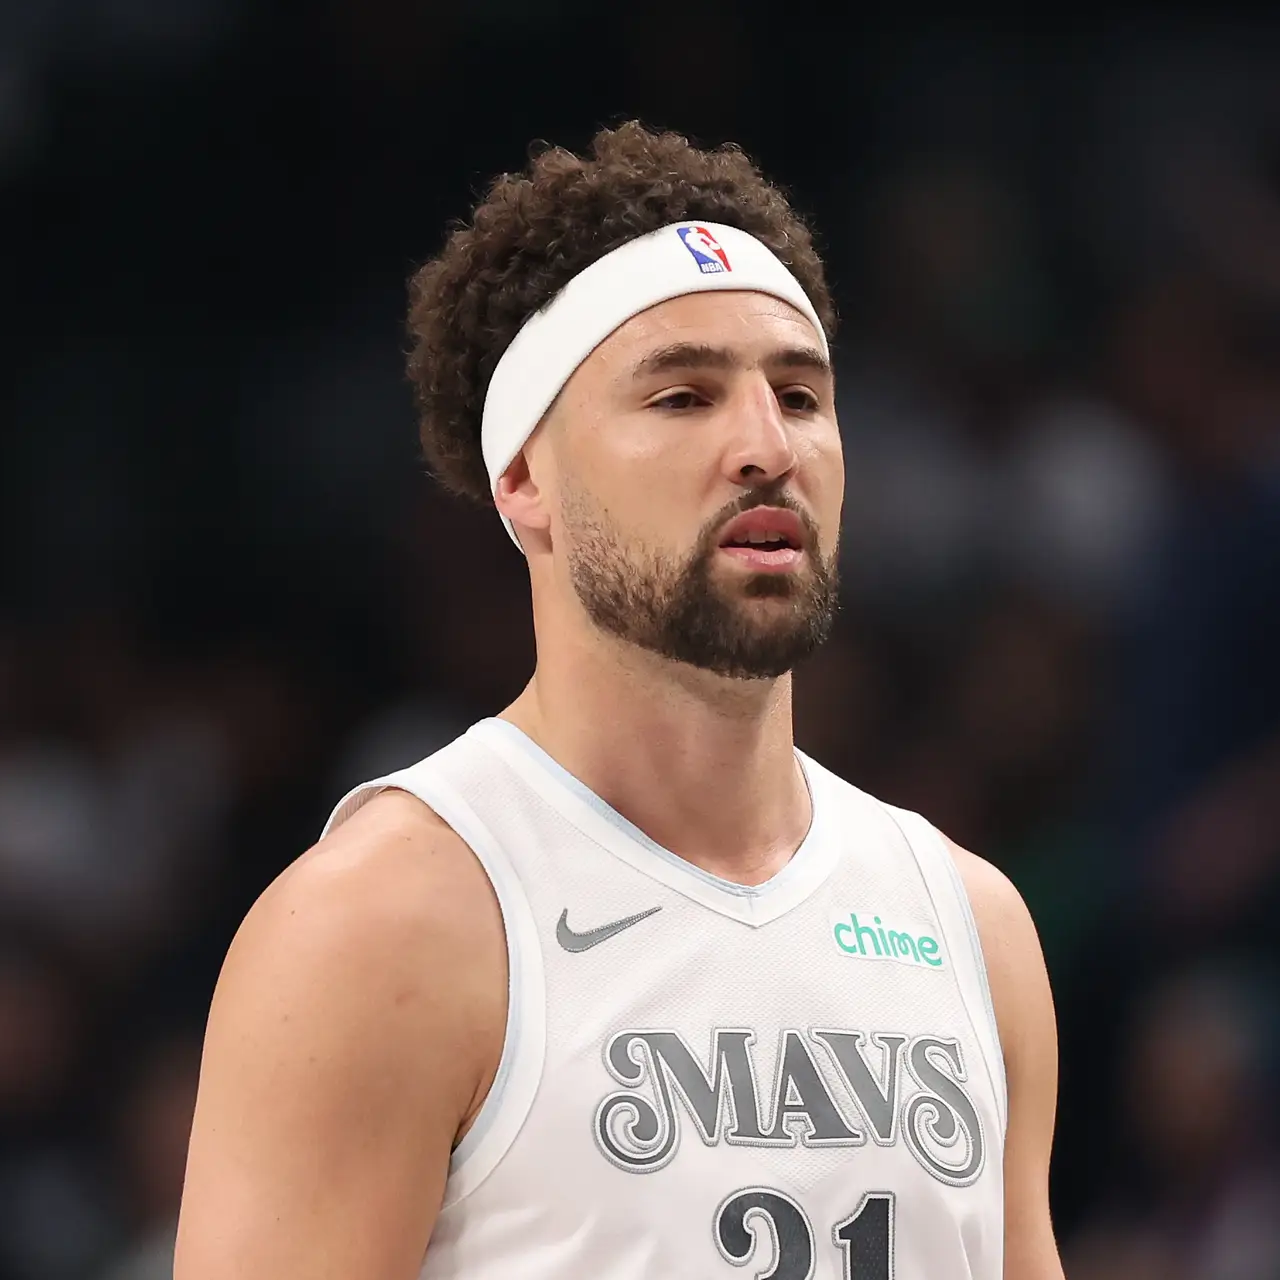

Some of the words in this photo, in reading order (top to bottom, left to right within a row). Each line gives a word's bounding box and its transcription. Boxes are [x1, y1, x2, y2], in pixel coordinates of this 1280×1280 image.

[700, 262, 723, 273] NBA
[833, 913, 943, 966] chime
[592, 1027, 985, 1187] MAVS
